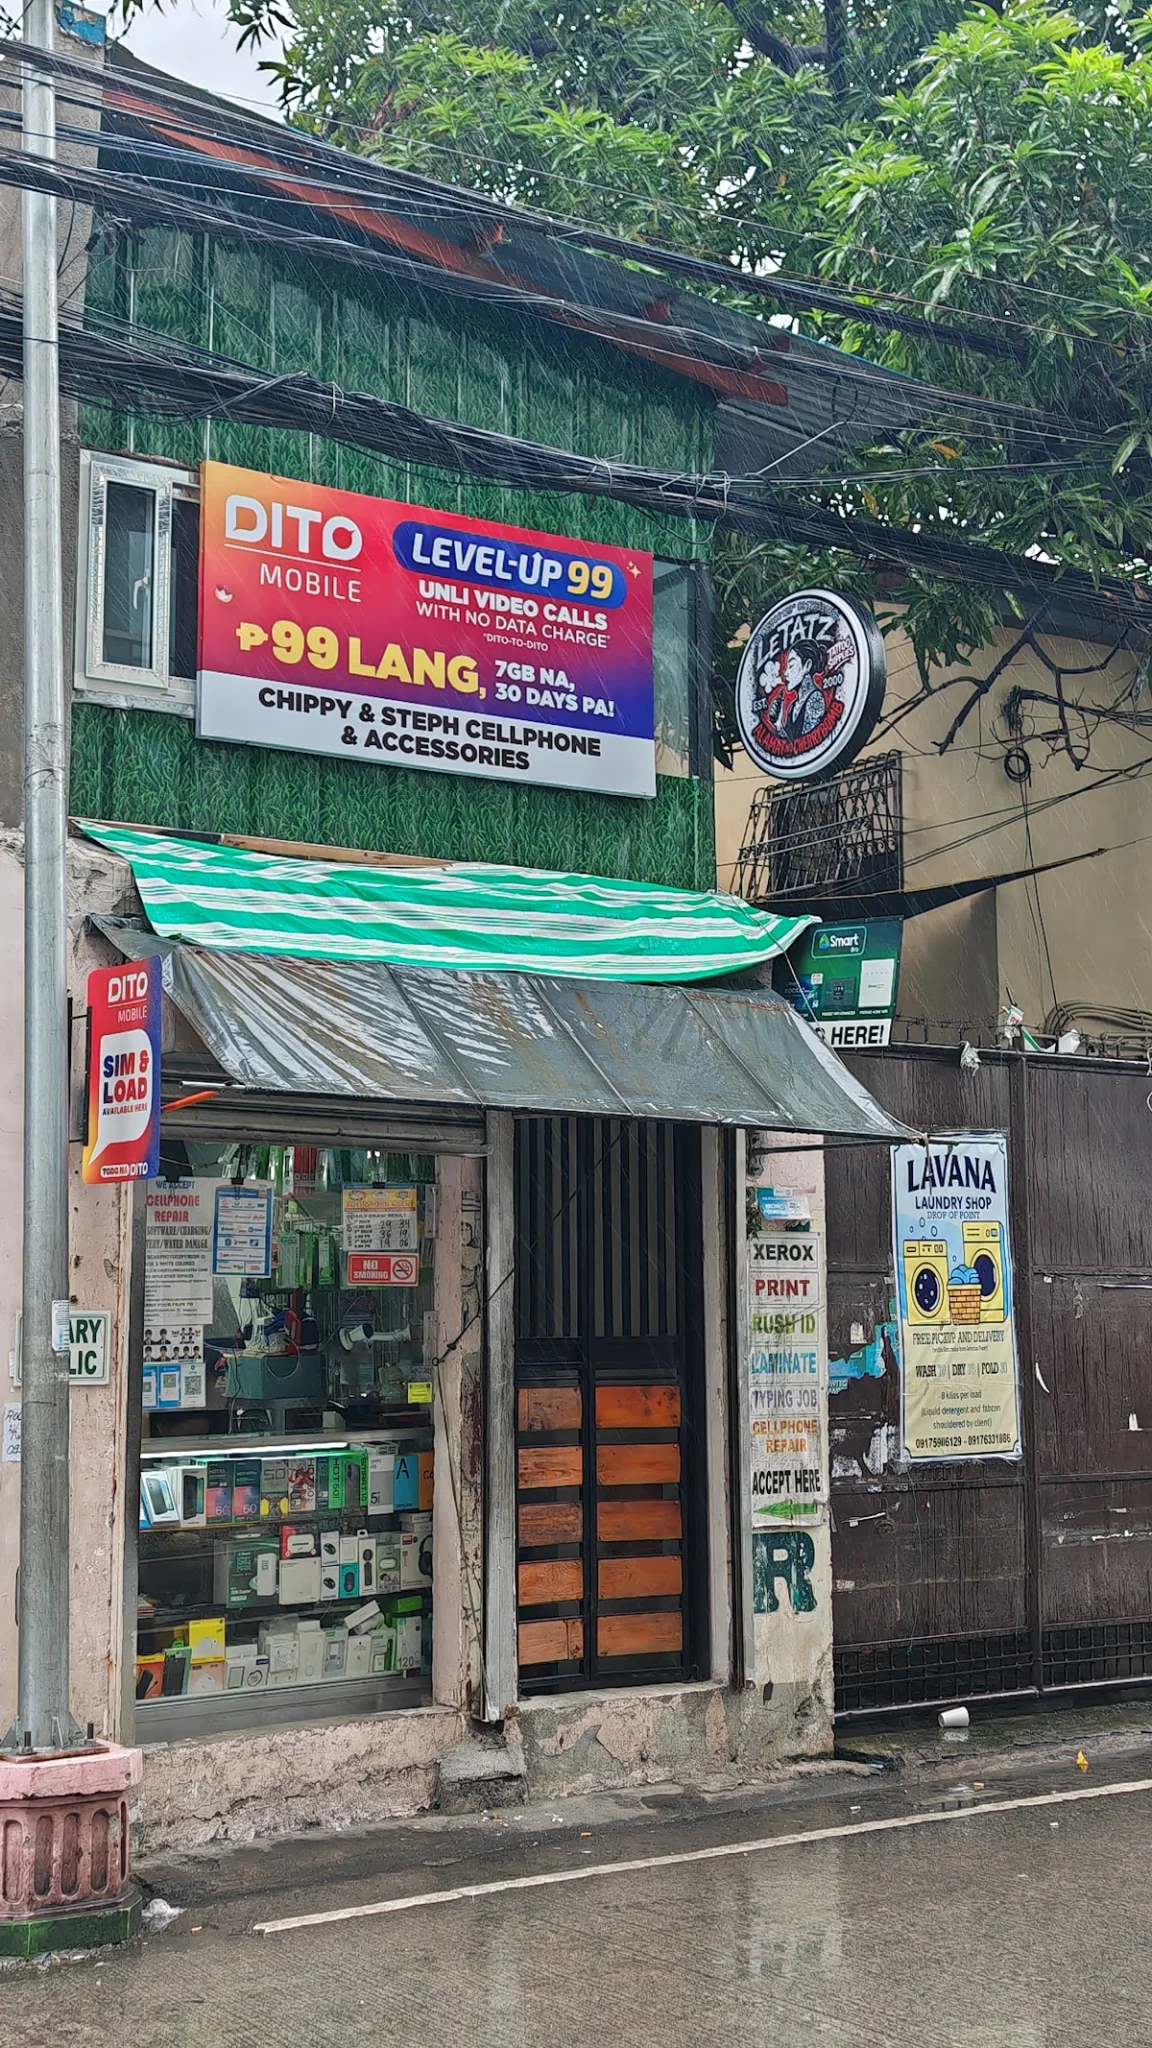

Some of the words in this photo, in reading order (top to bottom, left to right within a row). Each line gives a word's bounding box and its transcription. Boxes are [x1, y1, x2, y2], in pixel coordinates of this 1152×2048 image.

[225, 494, 363, 561] DITO
[412, 533, 563, 588] LEVEL-UP
[567, 561, 613, 599] 99
[260, 563, 362, 603] MOBILE
[419, 580, 469, 605] UNLI
[473, 589, 539, 618] VIDEO
[543, 604, 608, 631] CALLS
[416, 601, 461, 622] WITH
[465, 610, 491, 628] NO
[496, 615, 537, 636] DATA
[349, 637, 487, 700] LANG,
[494, 659, 536, 682] 7GB
[540, 668, 576, 693] NA,
[823, 673, 843, 689] 2000
[495, 682, 522, 702] 30
[526, 687, 579, 712] DAYS
[582, 696, 615, 718] PA!
[753, 698, 767, 712] EST.
[258, 687, 353, 719] CHIPPY
[359, 703, 376, 723] &
[381, 706, 459, 736] STEPH
[465, 719, 602, 757] CELLPHONE
[341, 725, 358, 746] &
[364, 729, 530, 770] ACCESSORIES
[830, 933, 859, 948] Smart
[108, 971, 148, 1004] DITO
[118, 1005, 148, 1023] MOBILE
[831, 1025, 884, 1045] HERE!
[103, 1053, 135, 1079] SIM
[139, 1050, 149, 1074] &
[103, 1077, 148, 1104] LOAD
[102, 1105, 134, 1116] AVAILABLE
[134, 1104, 148, 1114] HERE
[130, 1162, 148, 1176] DITO
[907, 1154, 997, 1194] LAVANA
[156, 1181, 167, 1189] WE
[169, 1181, 195, 1189] ACCEPT
[146, 1195, 200, 1206] CELLPHONE
[915, 1196, 963, 1210] LAUNDRY
[965, 1196, 992, 1210] SHOP
[155, 1211, 189, 1222] REPAIR
[927, 1211, 947, 1219] DROP
[949, 1211, 958, 1219] OF
[959, 1211, 980, 1219] POINT
[753, 1244, 814, 1261] XEROX
[363, 1260, 378, 1270] NO
[353, 1271, 388, 1279] SMOKING
[755, 1280, 810, 1296] PRINT
[752, 1314, 796, 1334] RUSH
[800, 1314, 816, 1331] ID
[912, 1333, 930, 1345] FREE
[957, 1331, 973, 1343] AND
[973, 1330, 1005, 1343] DELIVERY
[751, 1352, 817, 1375] LAMINATE
[915, 1364, 937, 1378] WASH
[952, 1363, 966, 1376] DRY
[981, 1362, 999, 1375] FOLD
[752, 1389, 793, 1408] TYPING
[797, 1389, 818, 1408] JOB
[946, 1391, 959, 1400] kilos
[960, 1392, 969, 1401] per
[970, 1391, 982, 1399] load
[942, 1406, 969, 1416] detergent
[970, 1405, 980, 1413] and
[752, 1420, 818, 1435] CELLPHONE
[966, 1420, 973, 1429] by
[766, 1439, 807, 1453] REPAIR
[752, 1470, 791, 1495] ACCEPT
[794, 1469, 821, 1493] HERE
